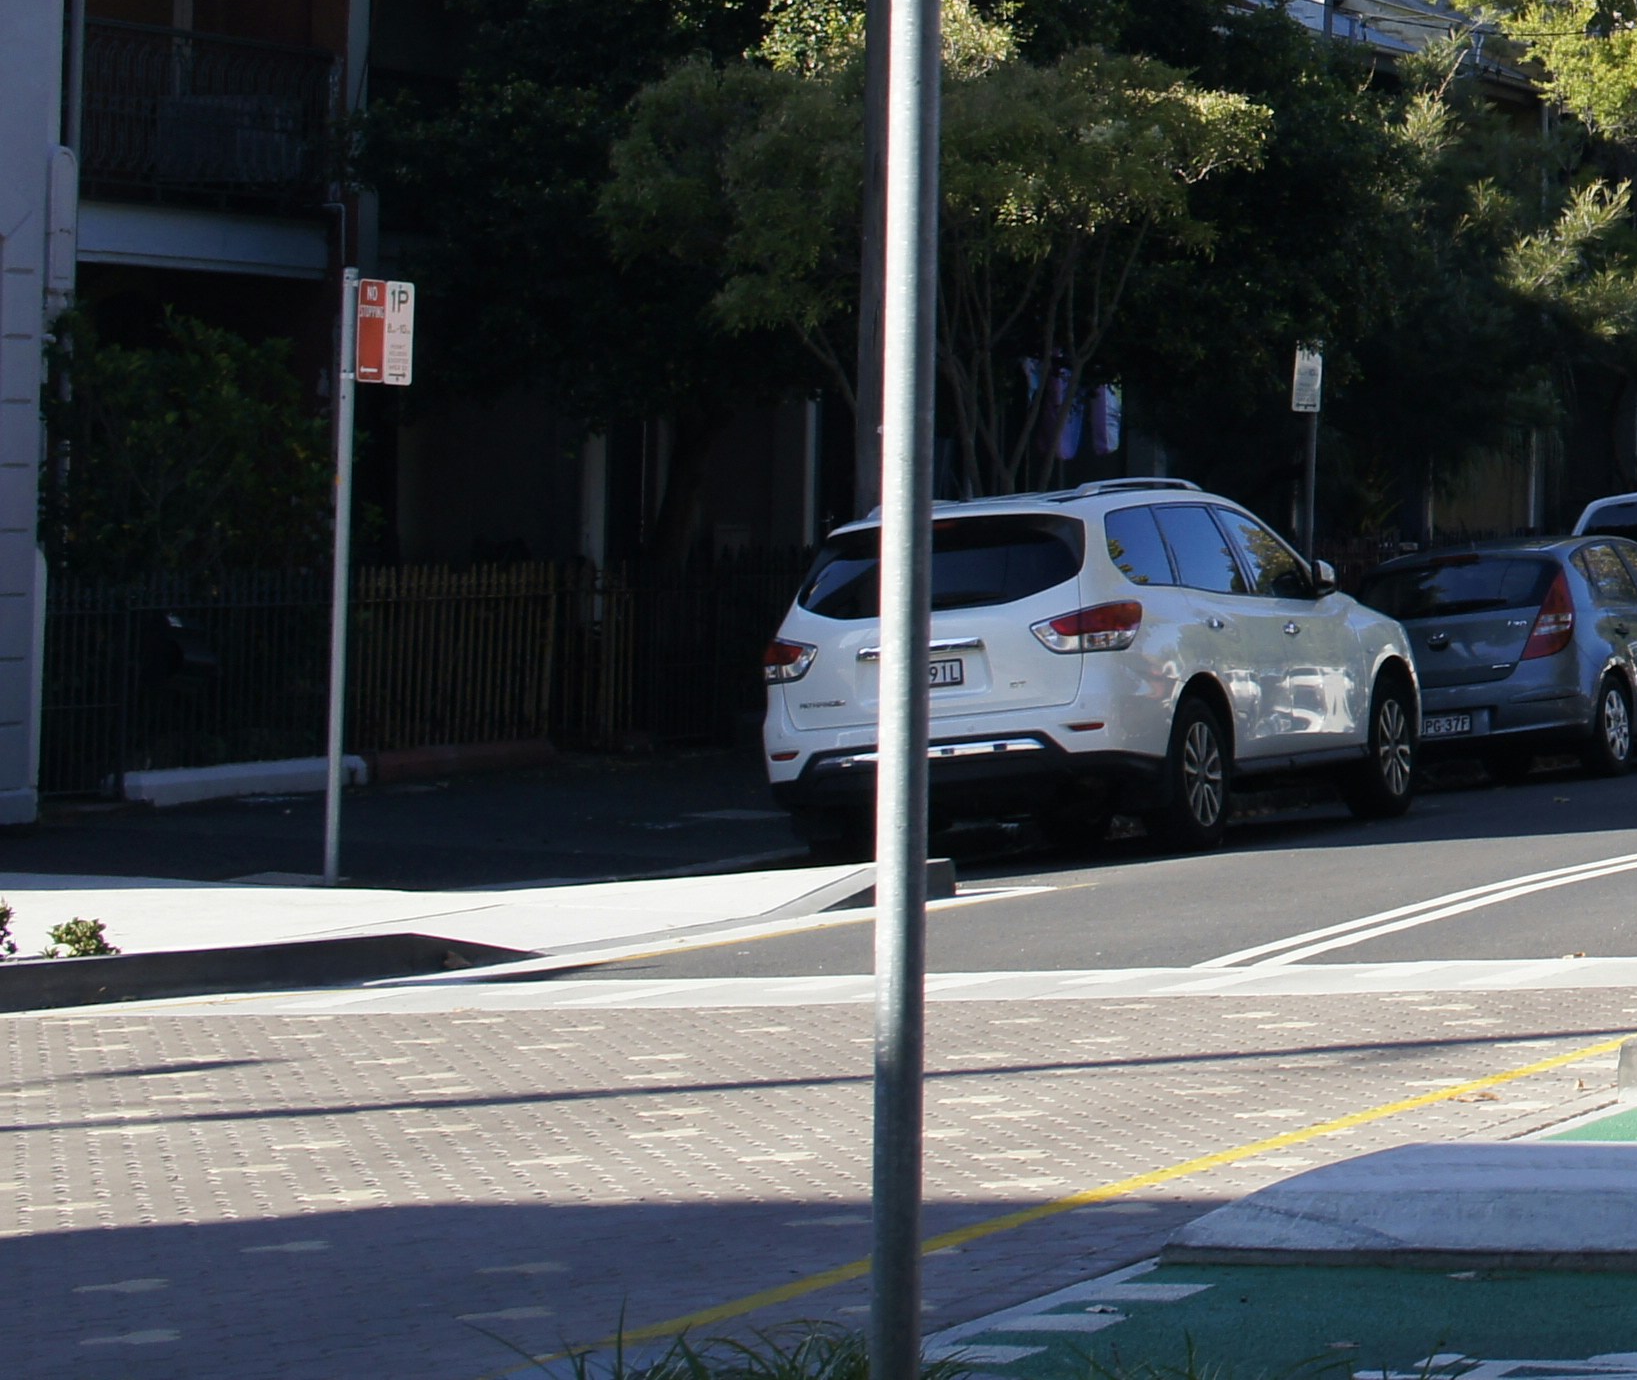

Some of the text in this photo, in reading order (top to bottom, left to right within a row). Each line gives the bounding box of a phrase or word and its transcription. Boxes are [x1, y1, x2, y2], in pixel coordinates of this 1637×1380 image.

[366, 285, 378, 301] NO
[391, 289, 409, 313] 1P
[360, 304, 385, 319] STOPPING
[929, 661, 961, 683] 91L
